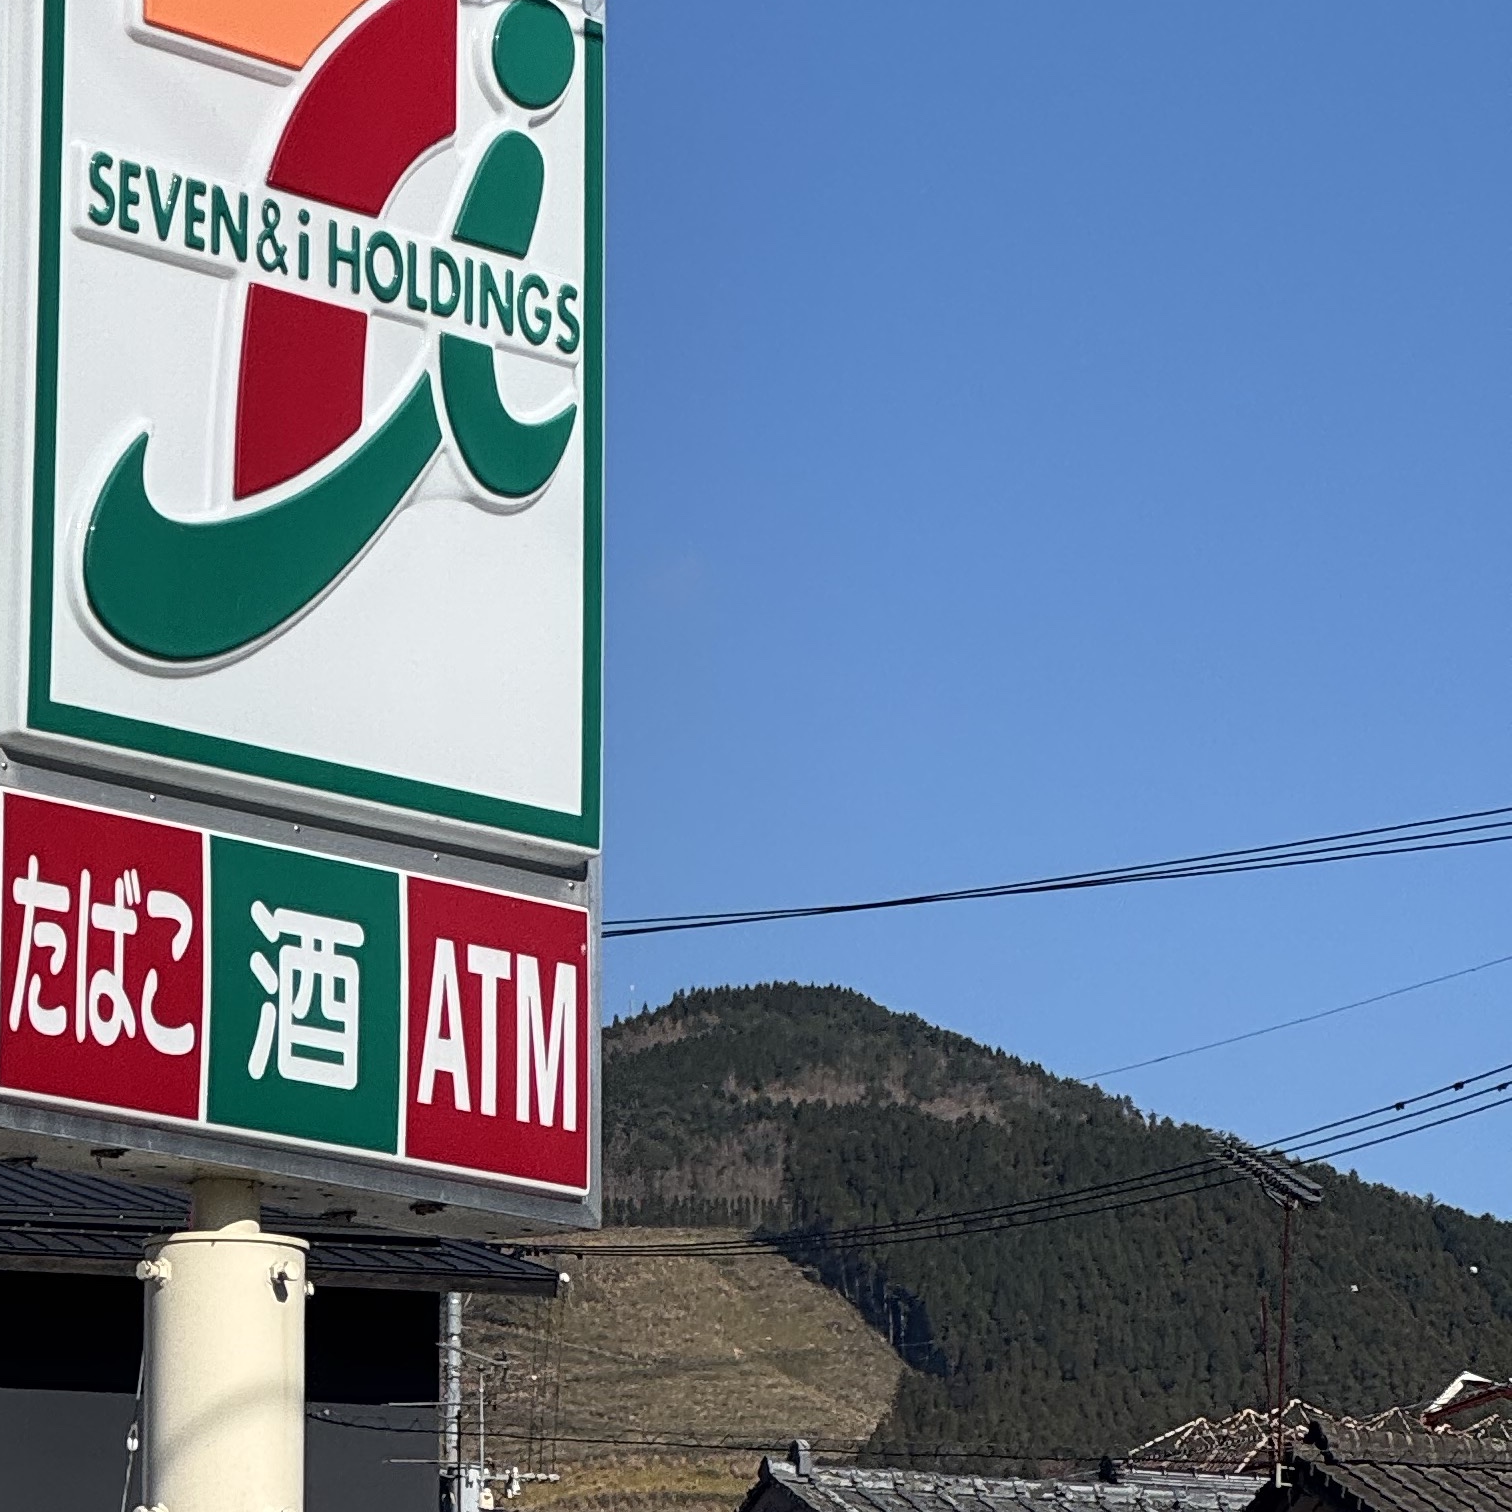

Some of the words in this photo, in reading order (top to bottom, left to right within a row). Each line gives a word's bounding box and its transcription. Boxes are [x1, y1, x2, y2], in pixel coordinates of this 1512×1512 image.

[328, 218, 581, 354] HOLDINGS
[8, 854, 195, 1057] たばこ
[247, 899, 365, 1091] 酒
[416, 937, 578, 1133] ATM
